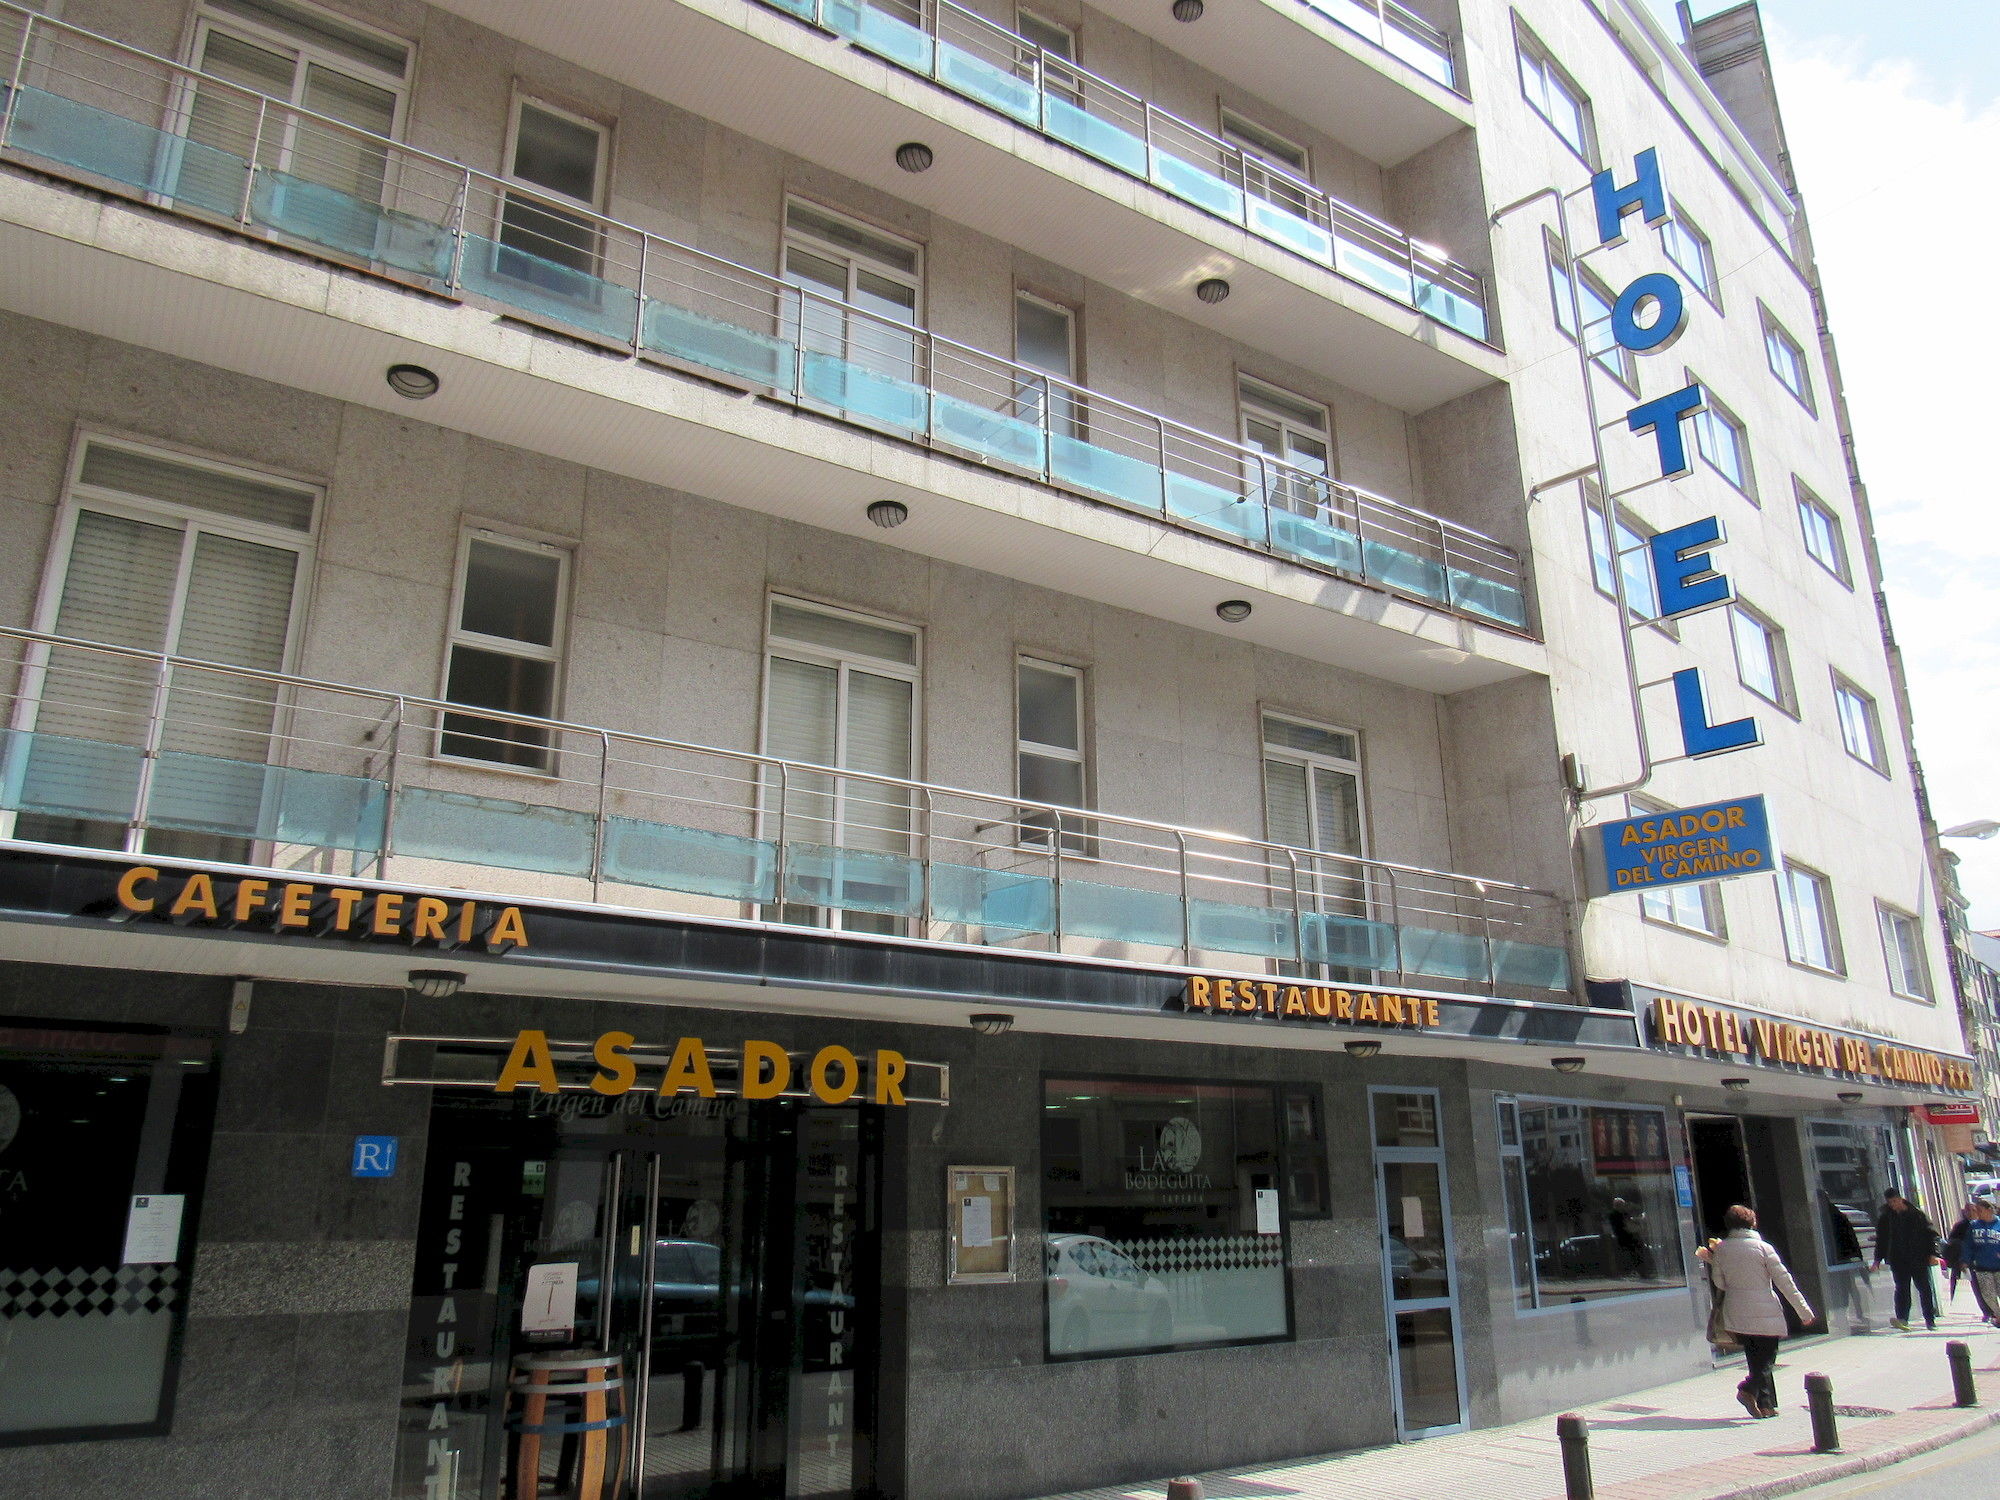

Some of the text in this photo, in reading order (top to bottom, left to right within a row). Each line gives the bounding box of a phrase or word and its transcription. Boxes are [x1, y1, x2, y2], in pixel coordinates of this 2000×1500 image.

[1591, 147, 1762, 757] HOTEL
[1621, 807, 1746, 846] ASADOR
[1616, 849, 1762, 886] DEL CAMINO
[1640, 837, 1728, 864] VIRGEN
[117, 866, 530, 948] CAFETERIA
[1189, 976, 1440, 1026] RESTAURANTE
[1655, 997, 1944, 1085] HOTEL VIRGEN DEL CAMINO
[495, 1030, 908, 1106] ASADOR
[529, 1089, 738, 1122] Virgen del Camino
[1139, 1146, 1166, 1171] LA
[1125, 1172, 1212, 1190] BODEGUITA
